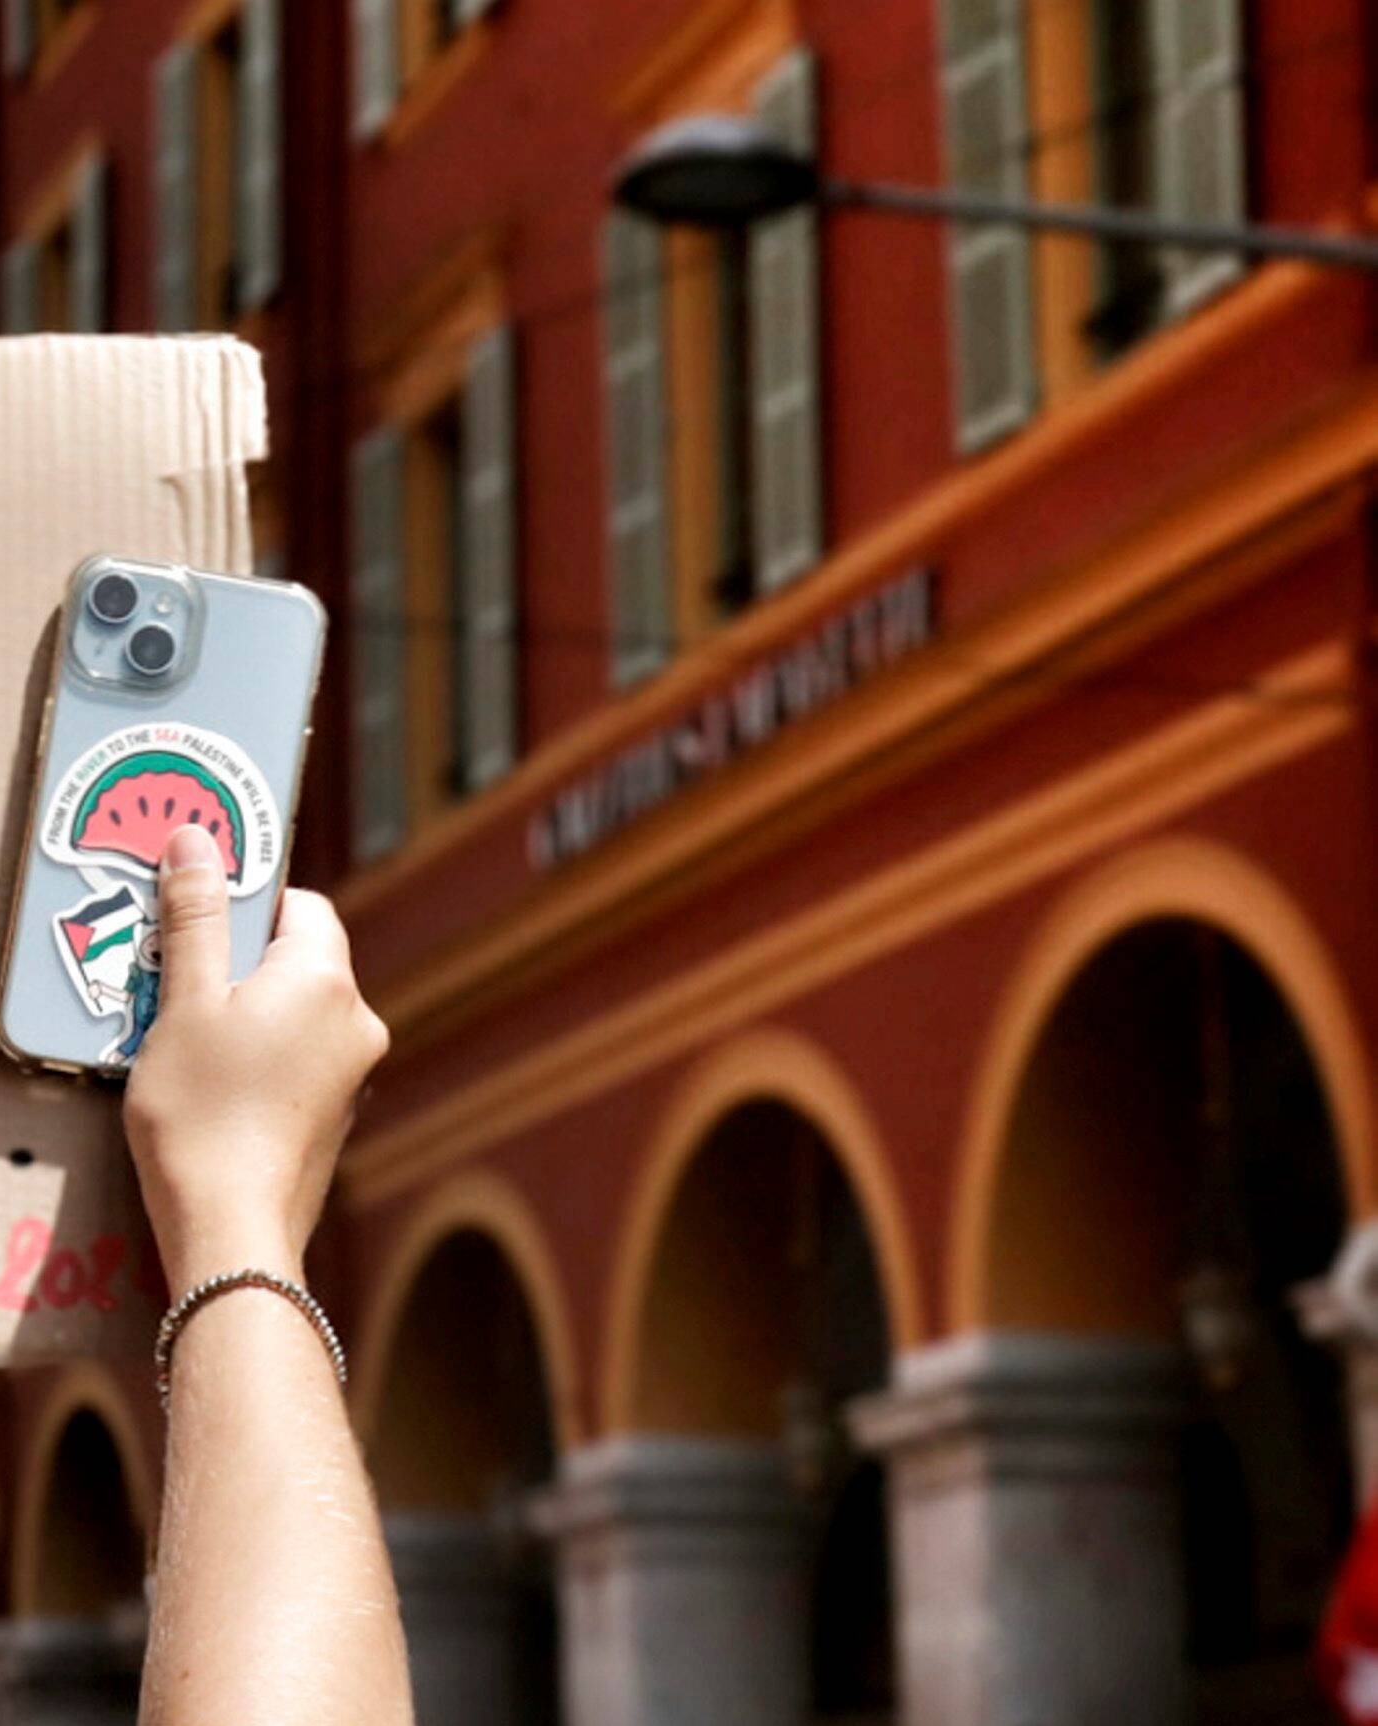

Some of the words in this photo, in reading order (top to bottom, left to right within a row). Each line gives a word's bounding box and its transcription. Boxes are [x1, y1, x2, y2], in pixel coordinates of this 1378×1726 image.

[47, 808, 67, 845] FROM
[60, 782, 79, 807] THE
[76, 750, 108, 780] RIVER
[107, 739, 126, 754] TO
[126, 730, 151, 746] THE
[155, 728, 179, 742] SEA
[183, 733, 244, 780] PALESTINE
[241, 775, 263, 808] WILL
[259, 830, 274, 864] FREE
